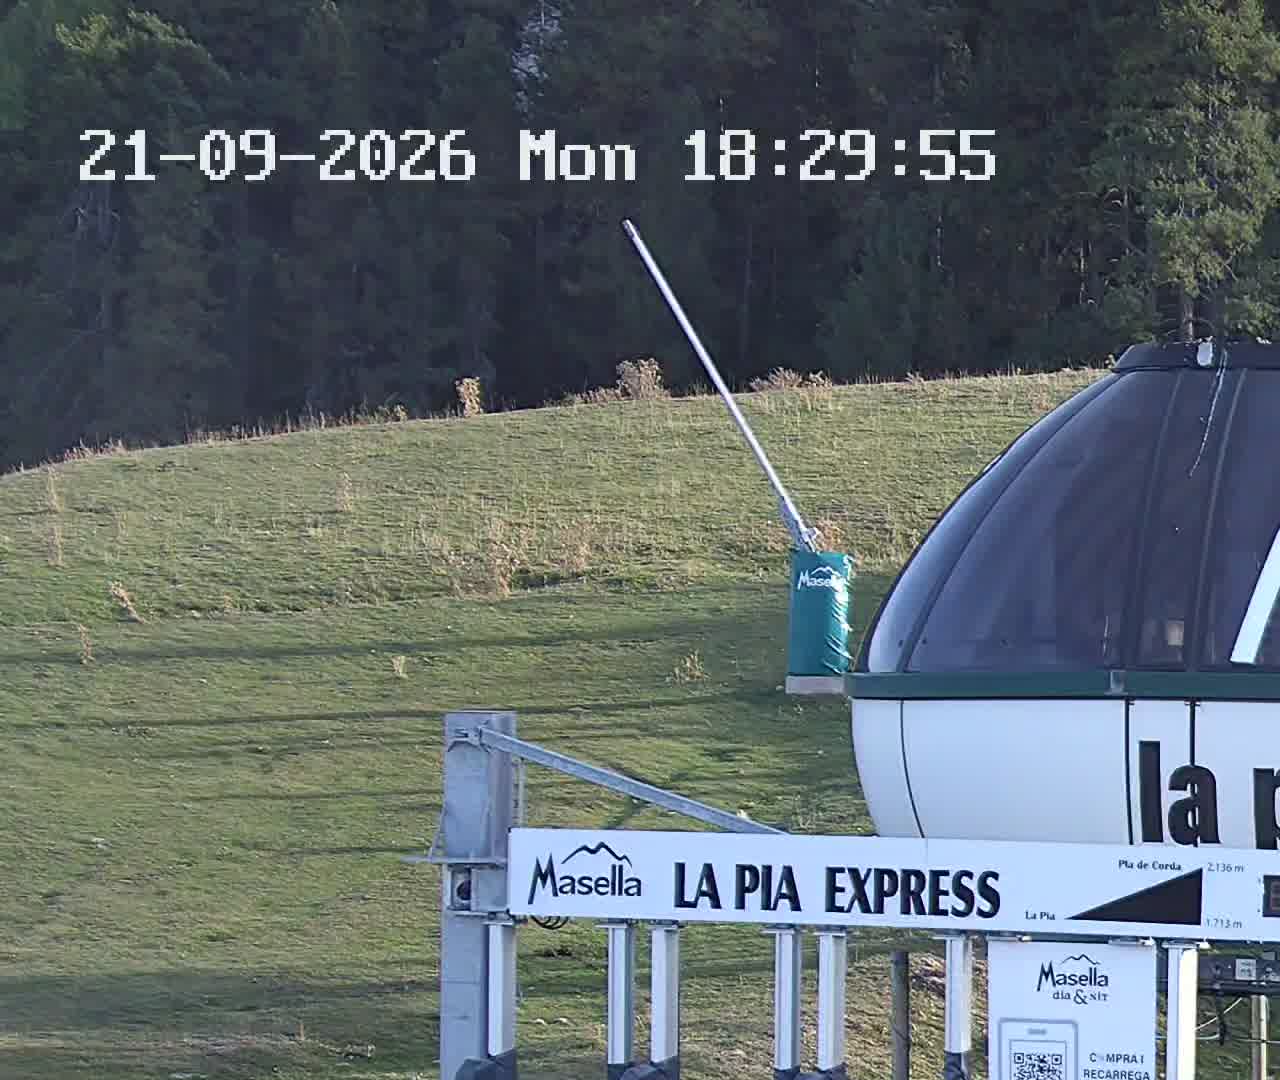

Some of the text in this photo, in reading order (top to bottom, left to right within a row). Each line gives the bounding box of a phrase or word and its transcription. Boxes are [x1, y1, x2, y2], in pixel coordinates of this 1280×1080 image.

[797, 569, 846, 590] Mase
[1139, 741, 1218, 846] la
[1137, 860, 1149, 869] de
[1152, 860, 1182, 871] Corda
[528, 853, 641, 904] Masella
[674, 862, 1001, 919] LA PIA EXPRESS
[1025, 910, 1037, 920] La
[1037, 960, 1109, 992] Masella
[1073, 988, 1088, 1005] &
[1089, 1052, 1138, 1064] CMPRA
[1083, 1068, 1150, 1080] RECARREGA
